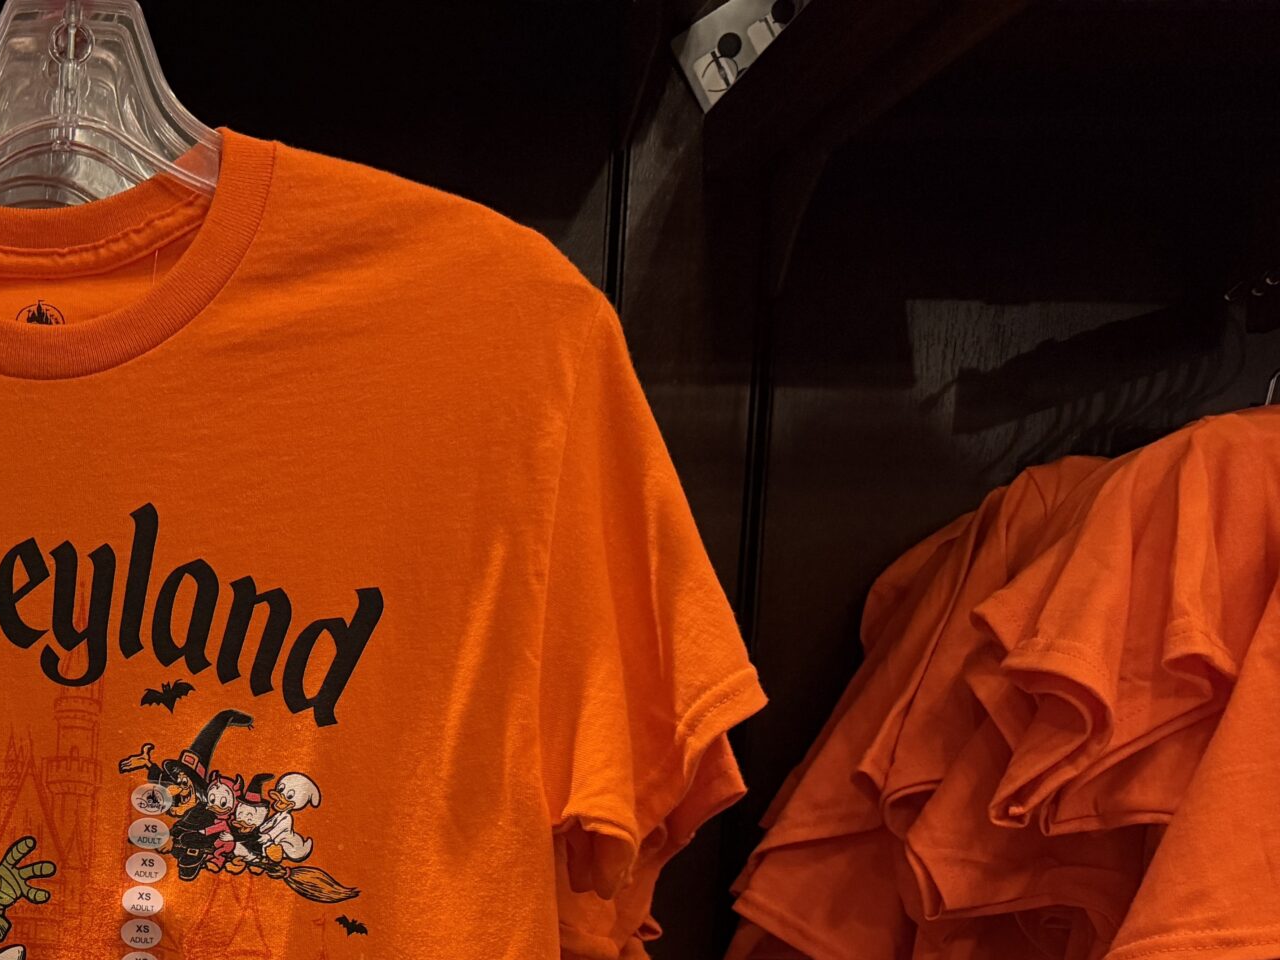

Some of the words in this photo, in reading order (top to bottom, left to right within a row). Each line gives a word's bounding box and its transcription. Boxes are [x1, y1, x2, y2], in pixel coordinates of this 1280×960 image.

[143, 823, 158, 833] XS
[136, 836, 163, 845] ADULT
[140, 857, 155, 868] XS
[134, 870, 159, 879] ADULT
[137, 891, 152, 901] XS
[130, 904, 155, 912] ADULT
[135, 924, 150, 934] XS
[129, 936, 154, 944] ADULT
